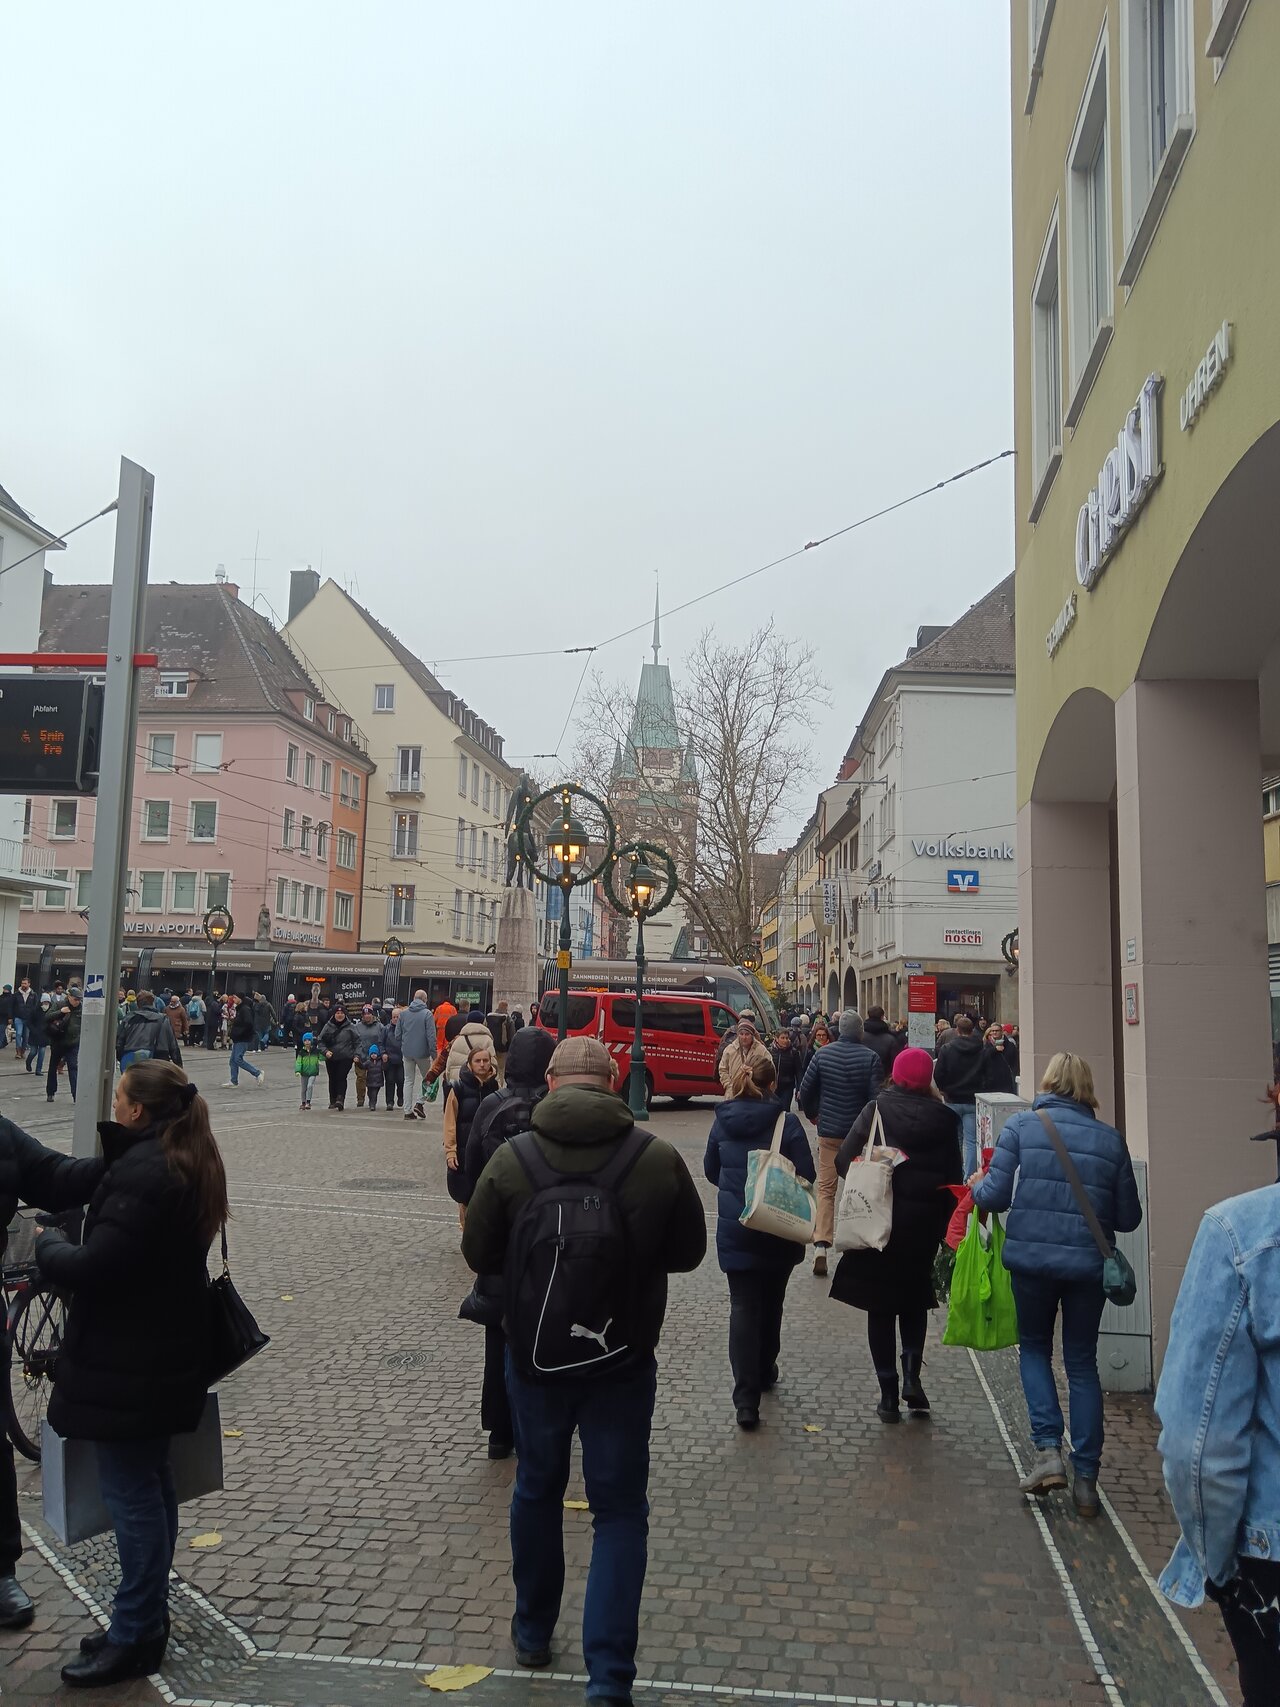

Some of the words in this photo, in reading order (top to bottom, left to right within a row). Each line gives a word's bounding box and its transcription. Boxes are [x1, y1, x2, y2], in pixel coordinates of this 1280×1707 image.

[1180, 319, 1230, 432] UHREN
[40, 730, 65, 741] 5min
[912, 840, 1014, 860] Volksbank
[124, 922, 154, 932] WEN
[946, 934, 981, 944] nosch
